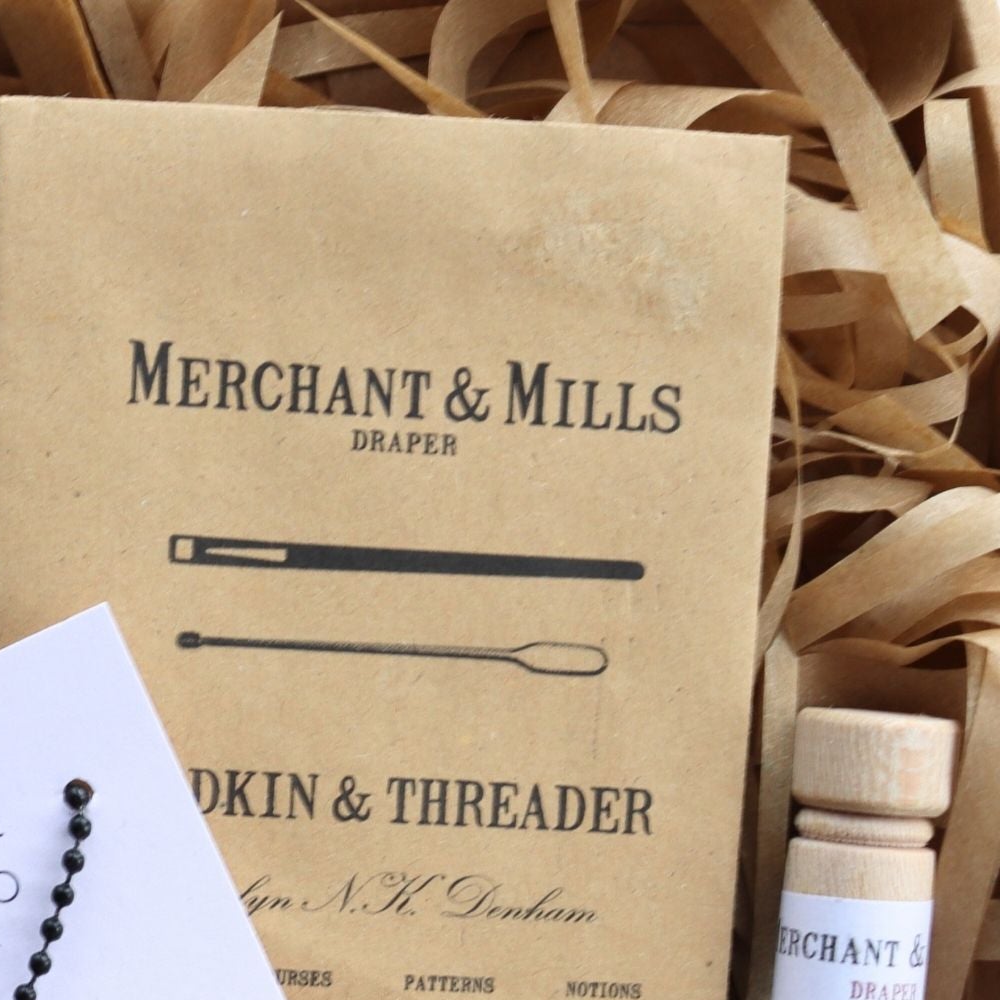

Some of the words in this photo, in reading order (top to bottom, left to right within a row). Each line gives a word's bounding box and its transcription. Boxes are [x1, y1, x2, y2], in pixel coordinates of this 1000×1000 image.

[126, 338, 431, 421] MERCHANT
[444, 366, 490, 423] &
[504, 360, 683, 434] MILLS
[351, 428, 458, 456] DRAPER
[188, 767, 320, 821] DKIN
[331, 774, 371, 822] &
[386, 776, 654, 836] THREADER
[440, 873, 600, 924] Denham
[777, 922, 901, 968] ERCHANT
[909, 932, 927, 968] &
[403, 973, 496, 994] PATTERNS
[565, 980, 643, 1000] NOTIONS
